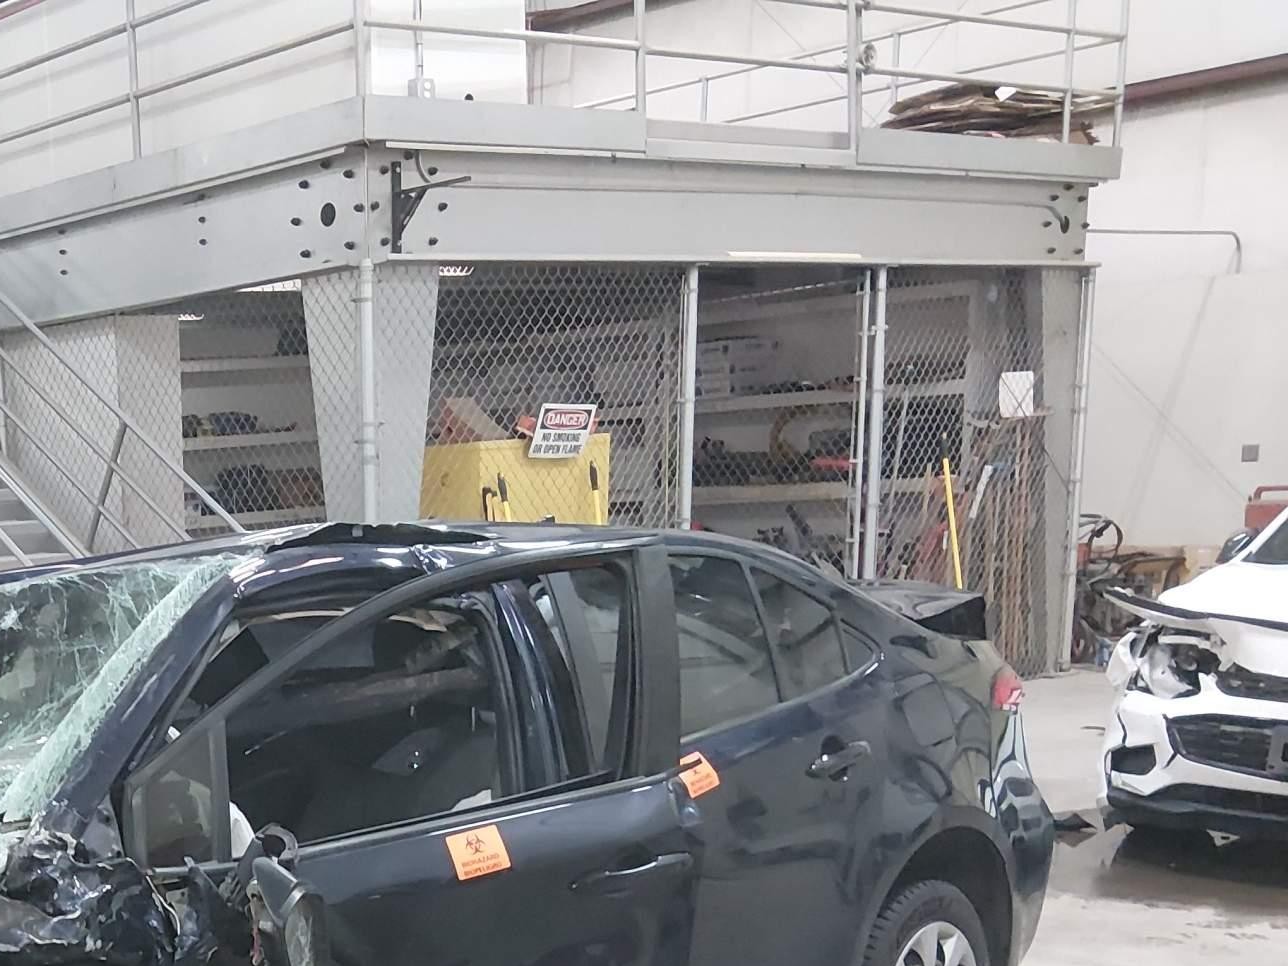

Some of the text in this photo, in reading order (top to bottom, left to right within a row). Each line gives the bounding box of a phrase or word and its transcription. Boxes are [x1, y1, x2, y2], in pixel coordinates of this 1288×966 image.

[546, 412, 586, 427] DANGER
[541, 432, 582, 443] NO SMOKING
[532, 443, 582, 455] OR OPEN FLAME
